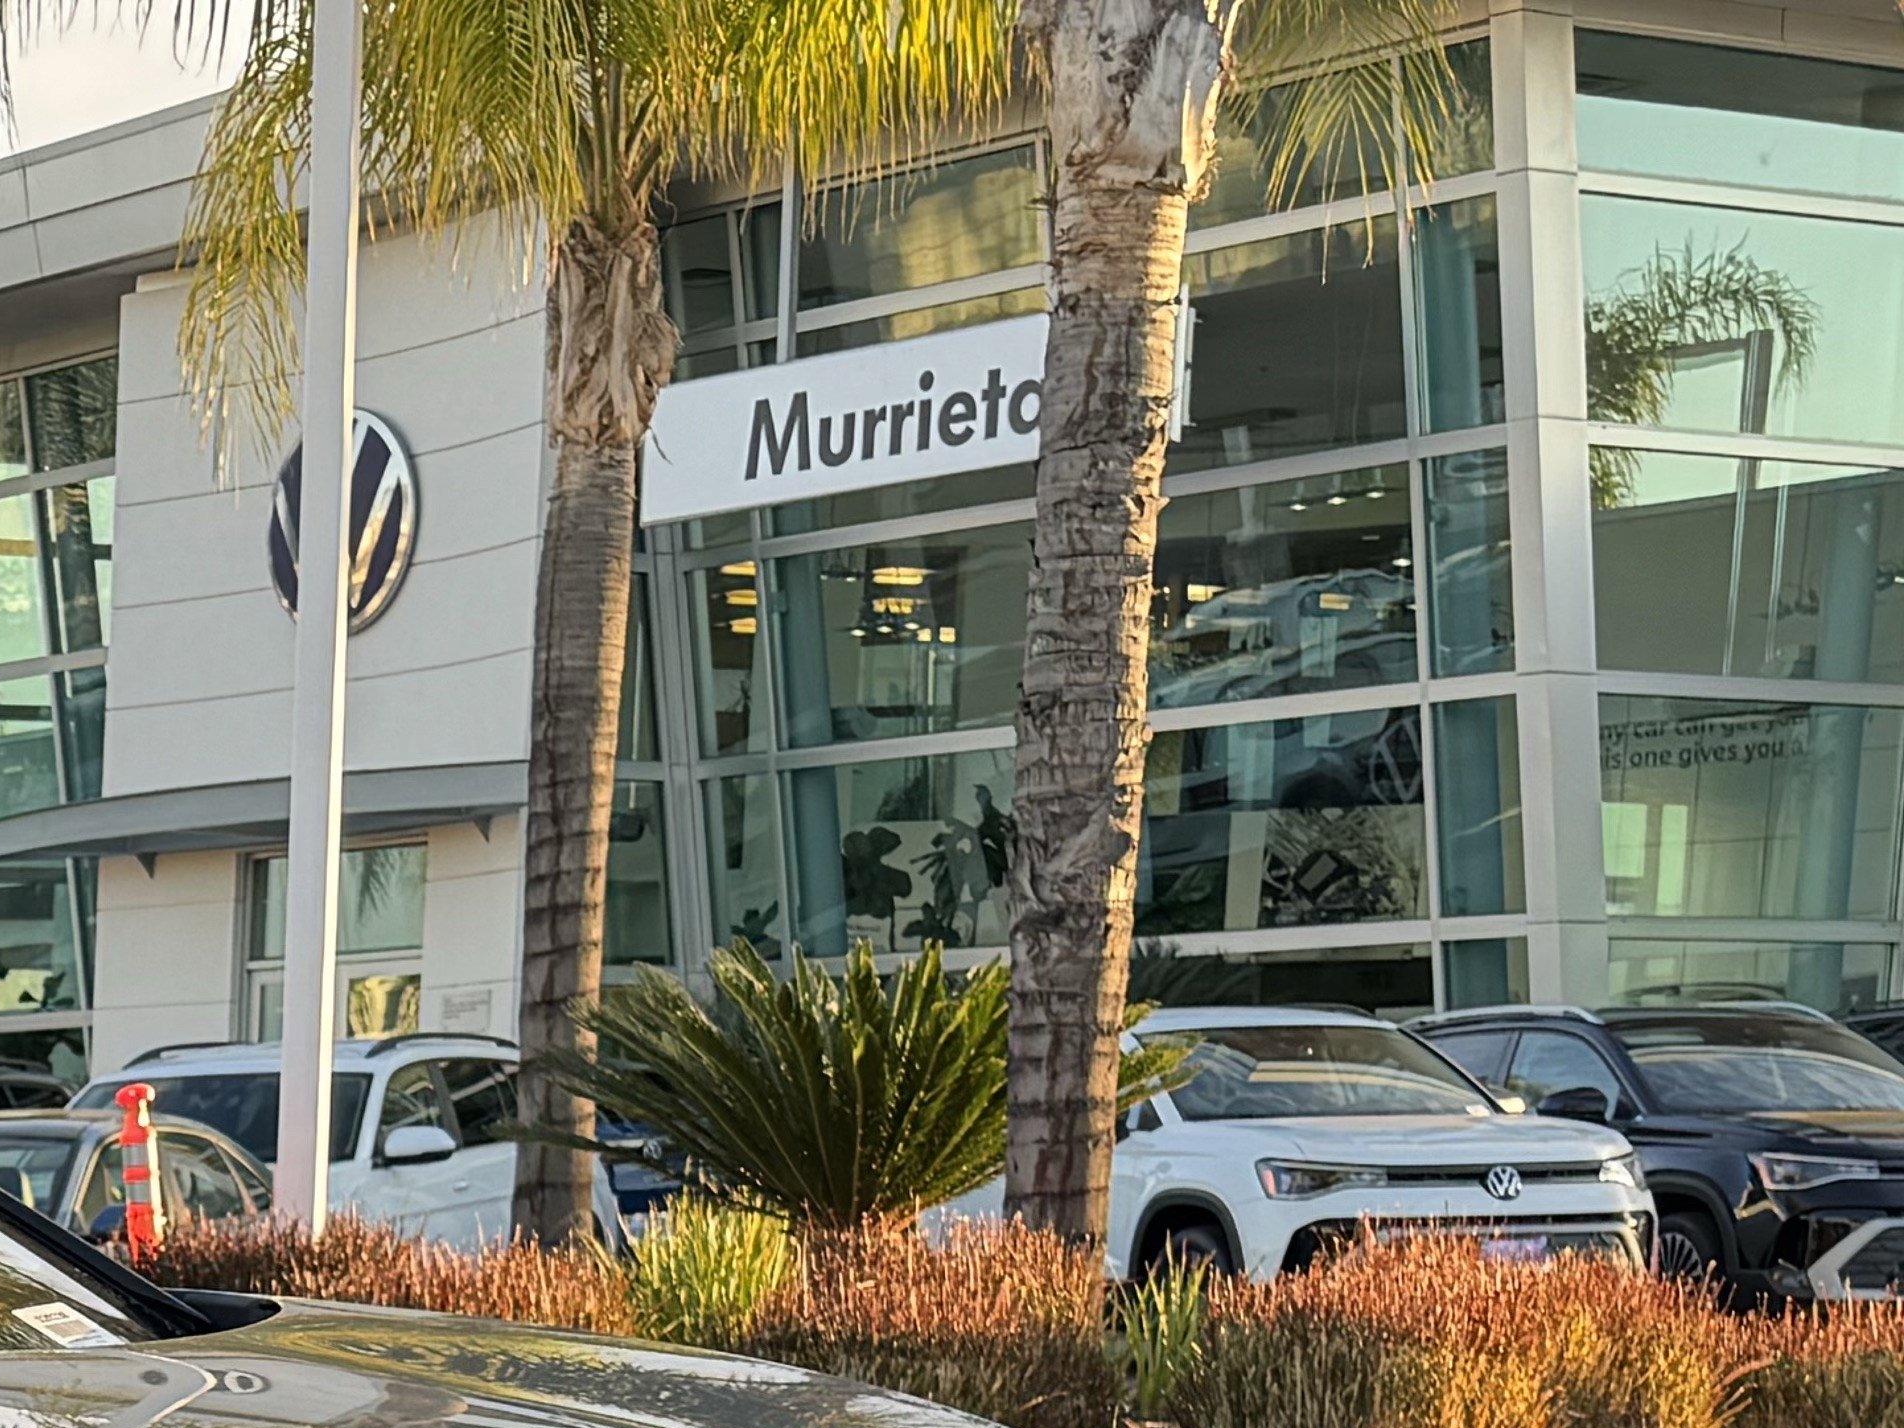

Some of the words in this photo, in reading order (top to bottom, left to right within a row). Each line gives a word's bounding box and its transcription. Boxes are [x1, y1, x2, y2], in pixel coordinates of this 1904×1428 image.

[1633, 720, 1668, 739] car
[1630, 750, 1672, 767] one
[1678, 740, 1738, 769] gives
[1744, 740, 1785, 764] you
